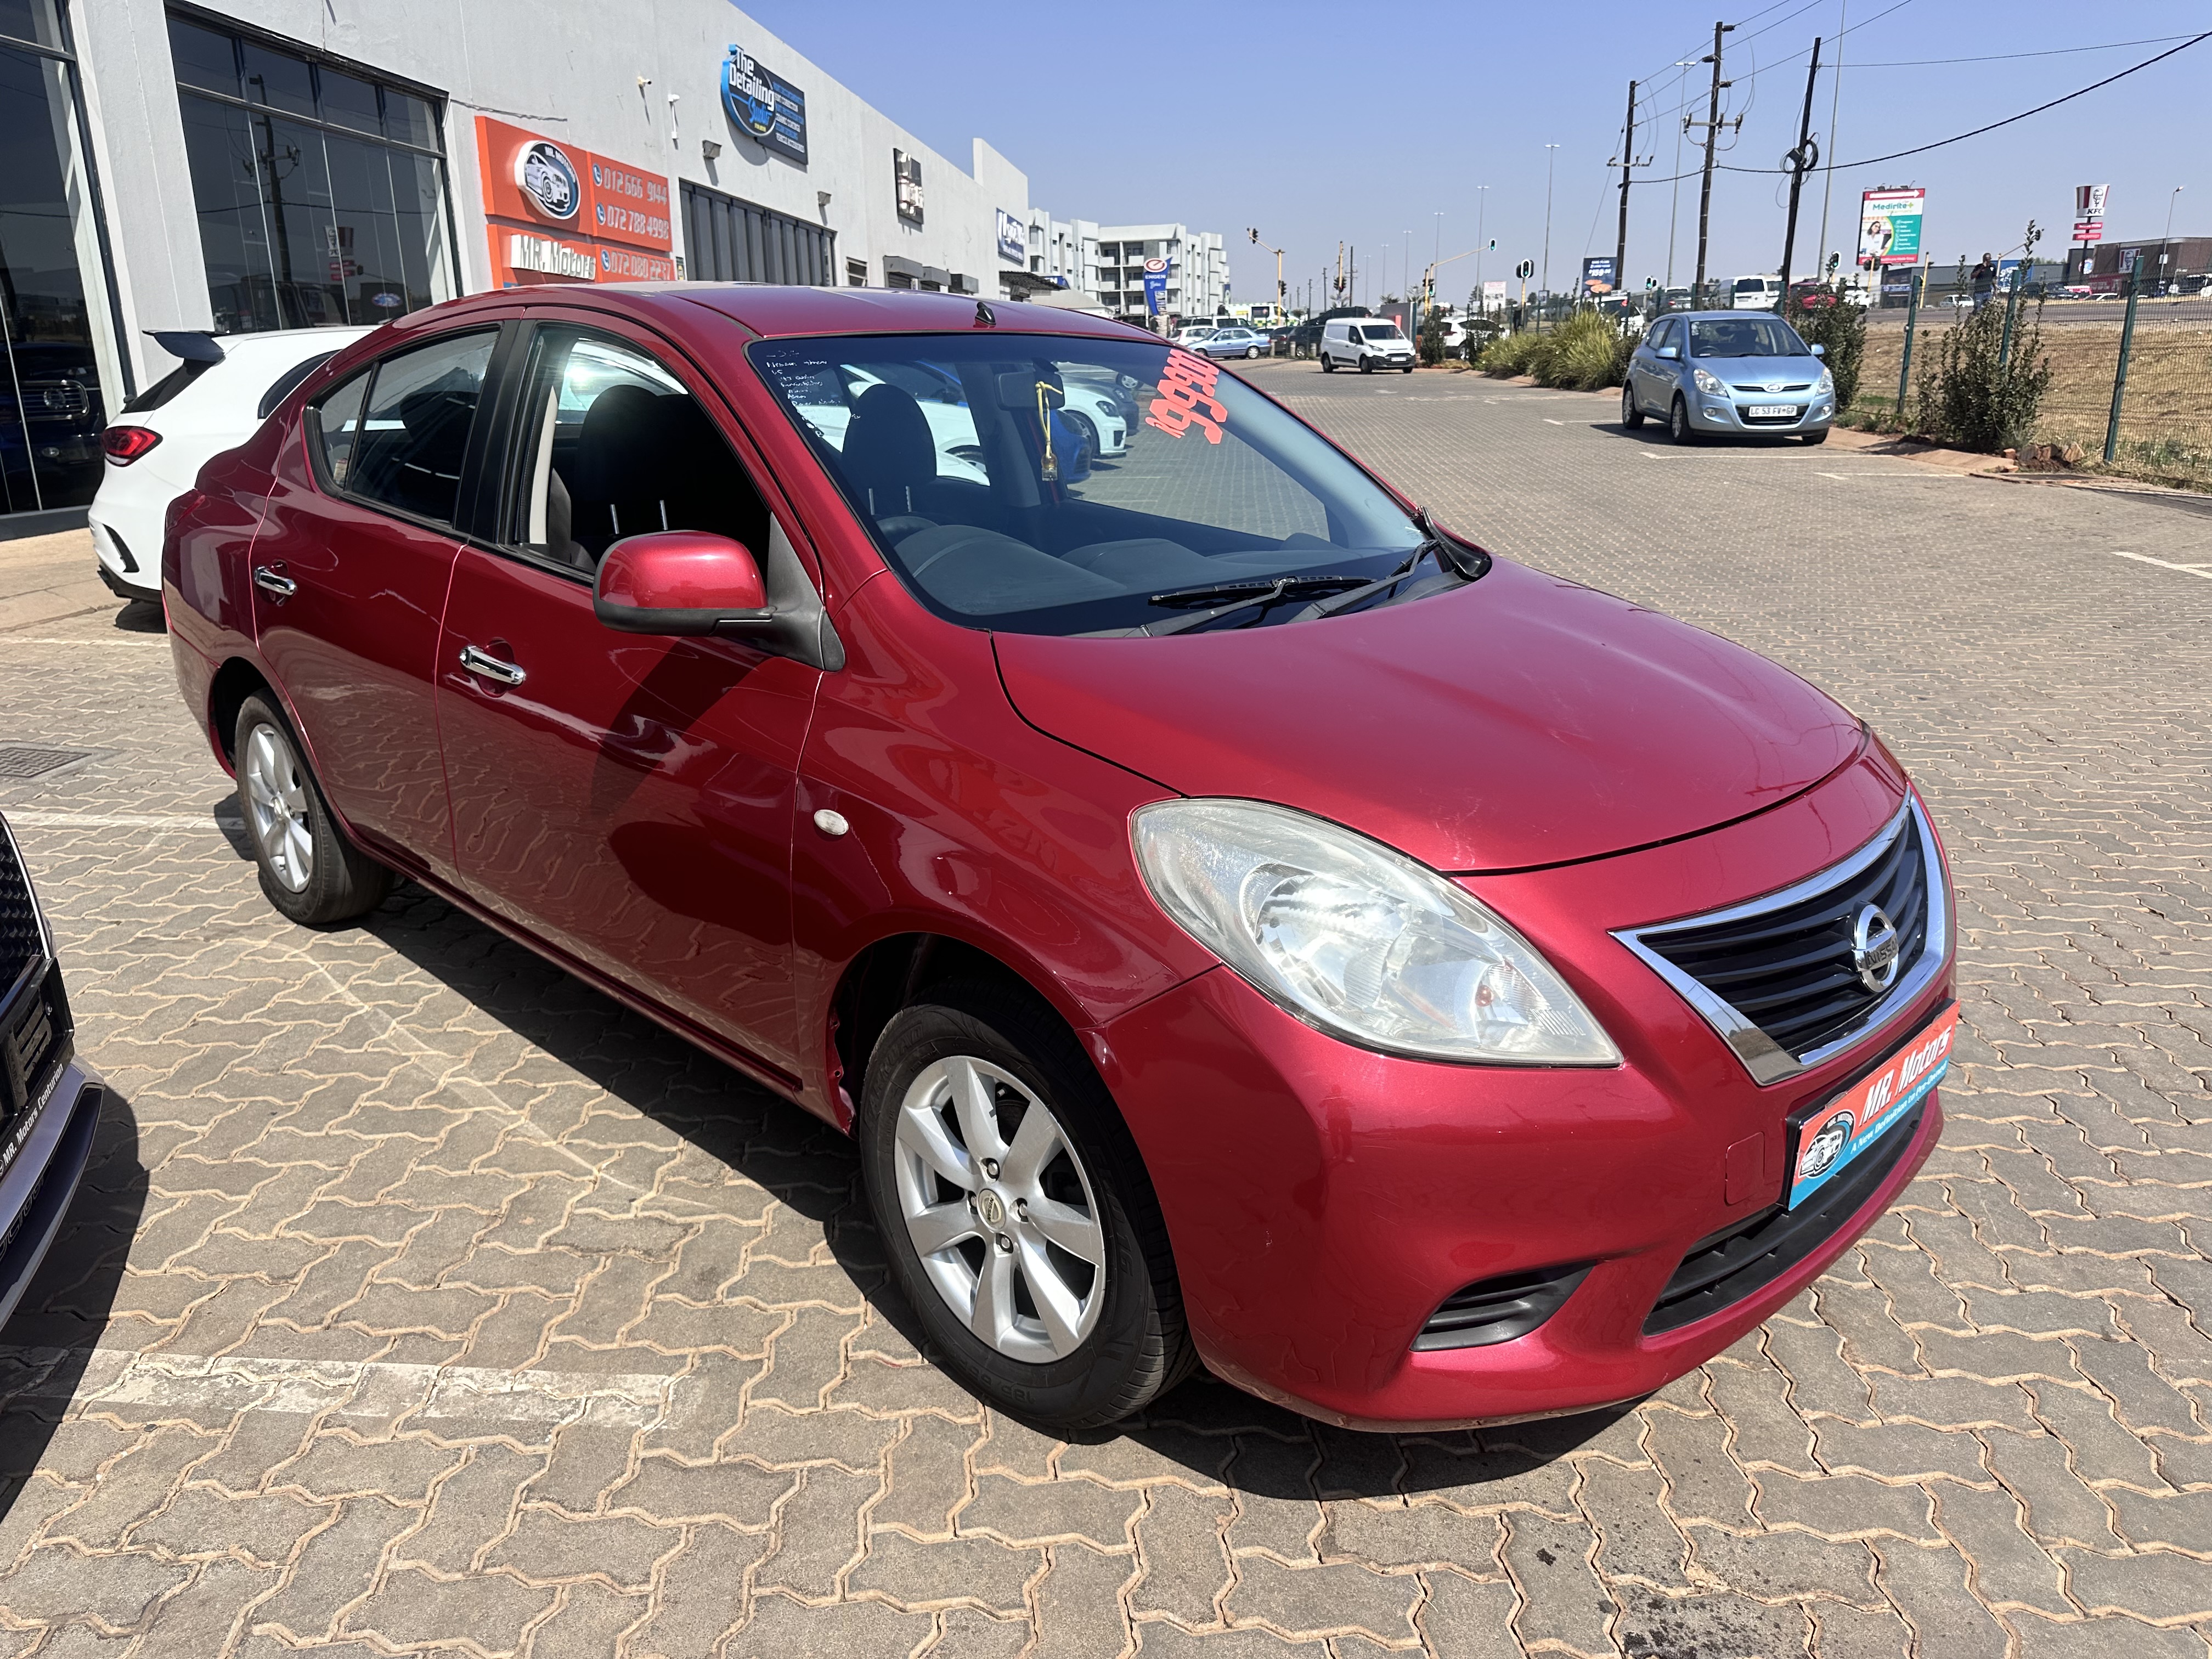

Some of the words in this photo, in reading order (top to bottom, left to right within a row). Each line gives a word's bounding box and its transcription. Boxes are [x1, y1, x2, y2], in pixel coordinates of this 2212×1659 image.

[736, 47, 754, 77] The
[729, 63, 775, 111] Detailing
[604, 167, 623, 193] 012
[625, 173, 643, 199] 666
[647, 180, 668, 206] 9144
[607, 204, 627, 230] 072
[628, 210, 646, 234] 788
[515, 235, 546, 270] MR.
[550, 241, 596, 280] Motors
[611, 251, 629, 275] 072
[631, 255, 648, 279] 080
[1859, 1069, 1894, 1127] MR.
[1895, 1025, 1953, 1096] Motors
[2, 1142, 18, 1166] MR.
[16, 1109, 38, 1146] Motors
[37, 1063, 64, 1110] Centurion
[1827, 1118, 1837, 1129] MR.
[1837, 1113, 1854, 1126] MOTORS
[1850, 1142, 1858, 1155] A
[1859, 1131, 1874, 1147] New
[1874, 1099, 1908, 1134] Definition
[1908, 1094, 1916, 1104] to
[1915, 1060, 1948, 1093] Pre-Owned
